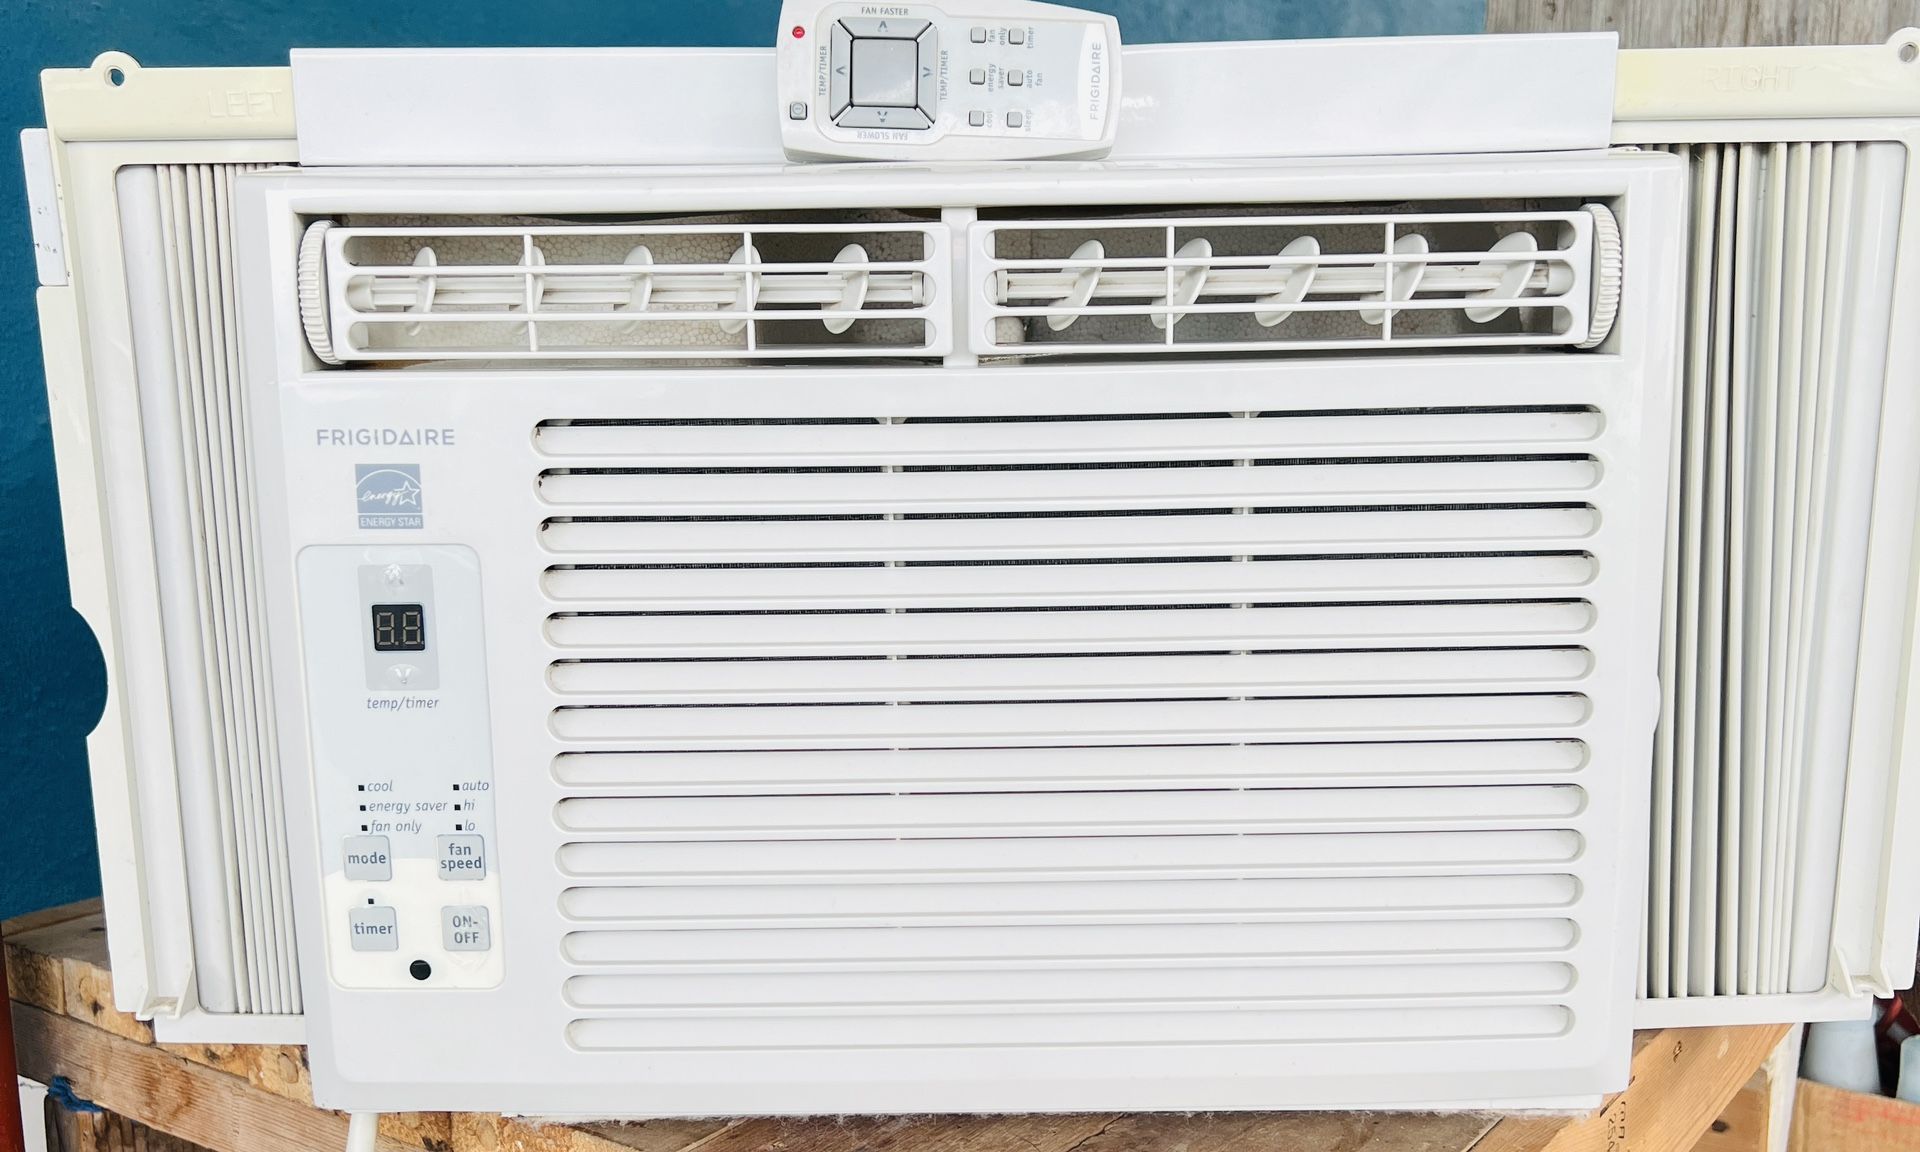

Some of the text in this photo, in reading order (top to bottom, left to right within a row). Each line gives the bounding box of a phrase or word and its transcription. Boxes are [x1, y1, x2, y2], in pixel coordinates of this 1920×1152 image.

[861, 6, 909, 16] FAN FASTER
[988, 29, 996, 43] fan
[998, 27, 1007, 46] only
[818, 46, 828, 97] TEMP/TIMER
[939, 50, 949, 101] TEMP/TIMER
[988, 63, 997, 93] energy
[1090, 43, 1102, 120] FRIGIDAIRE
[208, 88, 282, 118] LEFT
[856, 131, 909, 141] FAN SLOWER
[316, 428, 456, 446] FRIGIDAIRE
[360, 516, 421, 527] ENERGY STAR
[367, 696, 440, 712] temp/timer
[367, 780, 393, 792] cool
[462, 780, 490, 792] auto
[369, 801, 448, 814] energy saver
[463, 799, 475, 811] hi
[369, 819, 422, 835] fan only
[465, 820, 476, 832] lo
[448, 843, 472, 856] fan
[348, 851, 387, 864] mode
[440, 856, 482, 872] speed
[452, 915, 479, 928] ON-
[354, 922, 394, 935] timer
[454, 932, 480, 944] OFF
